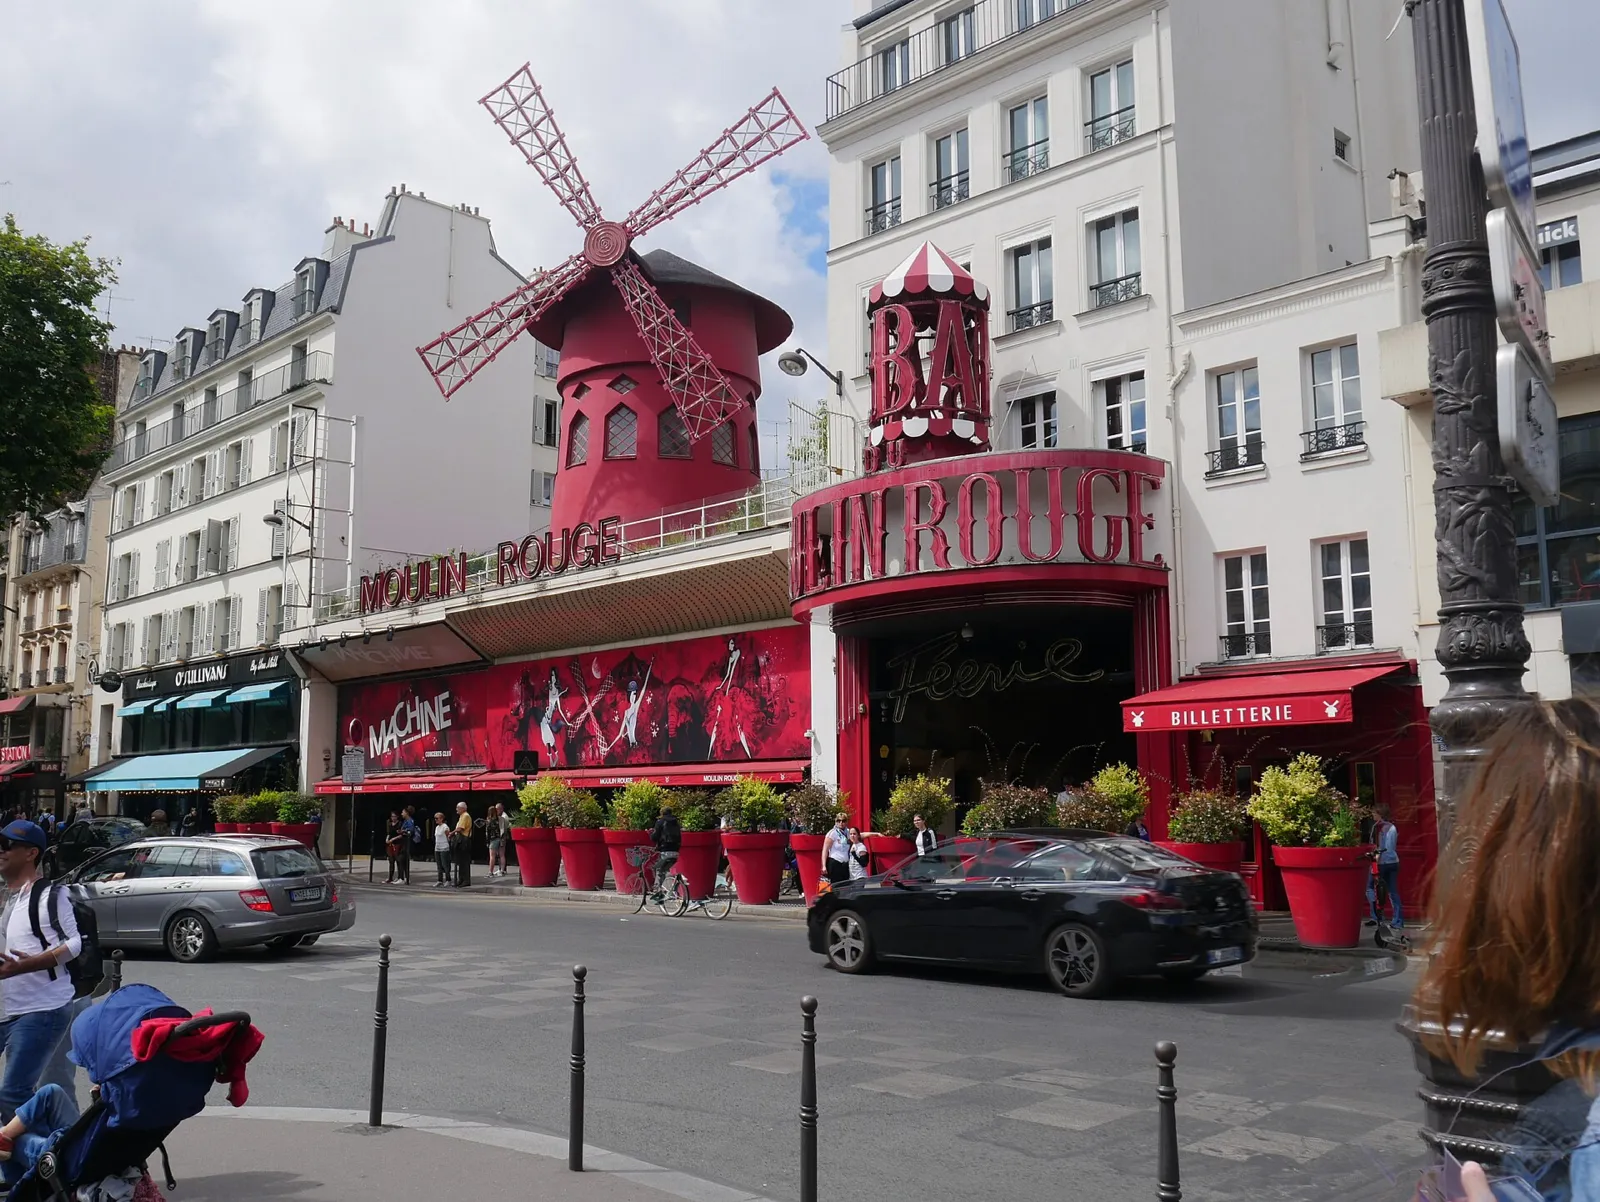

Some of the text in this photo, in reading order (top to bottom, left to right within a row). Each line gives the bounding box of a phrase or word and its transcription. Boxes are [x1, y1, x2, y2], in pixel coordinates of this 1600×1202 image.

[1537, 221, 1577, 245] ick
[902, 466, 1166, 574] ROUGE
[359, 515, 621, 614] MOULIN ROUGE
[175, 664, 229, 687] O'SULLIVANS
[249, 659, 258, 675] By
[368, 690, 453, 759] MACHINE
[1170, 704, 1293, 727] BILLETTERIE
[703, 774, 741, 783] MOULIN ROUG
